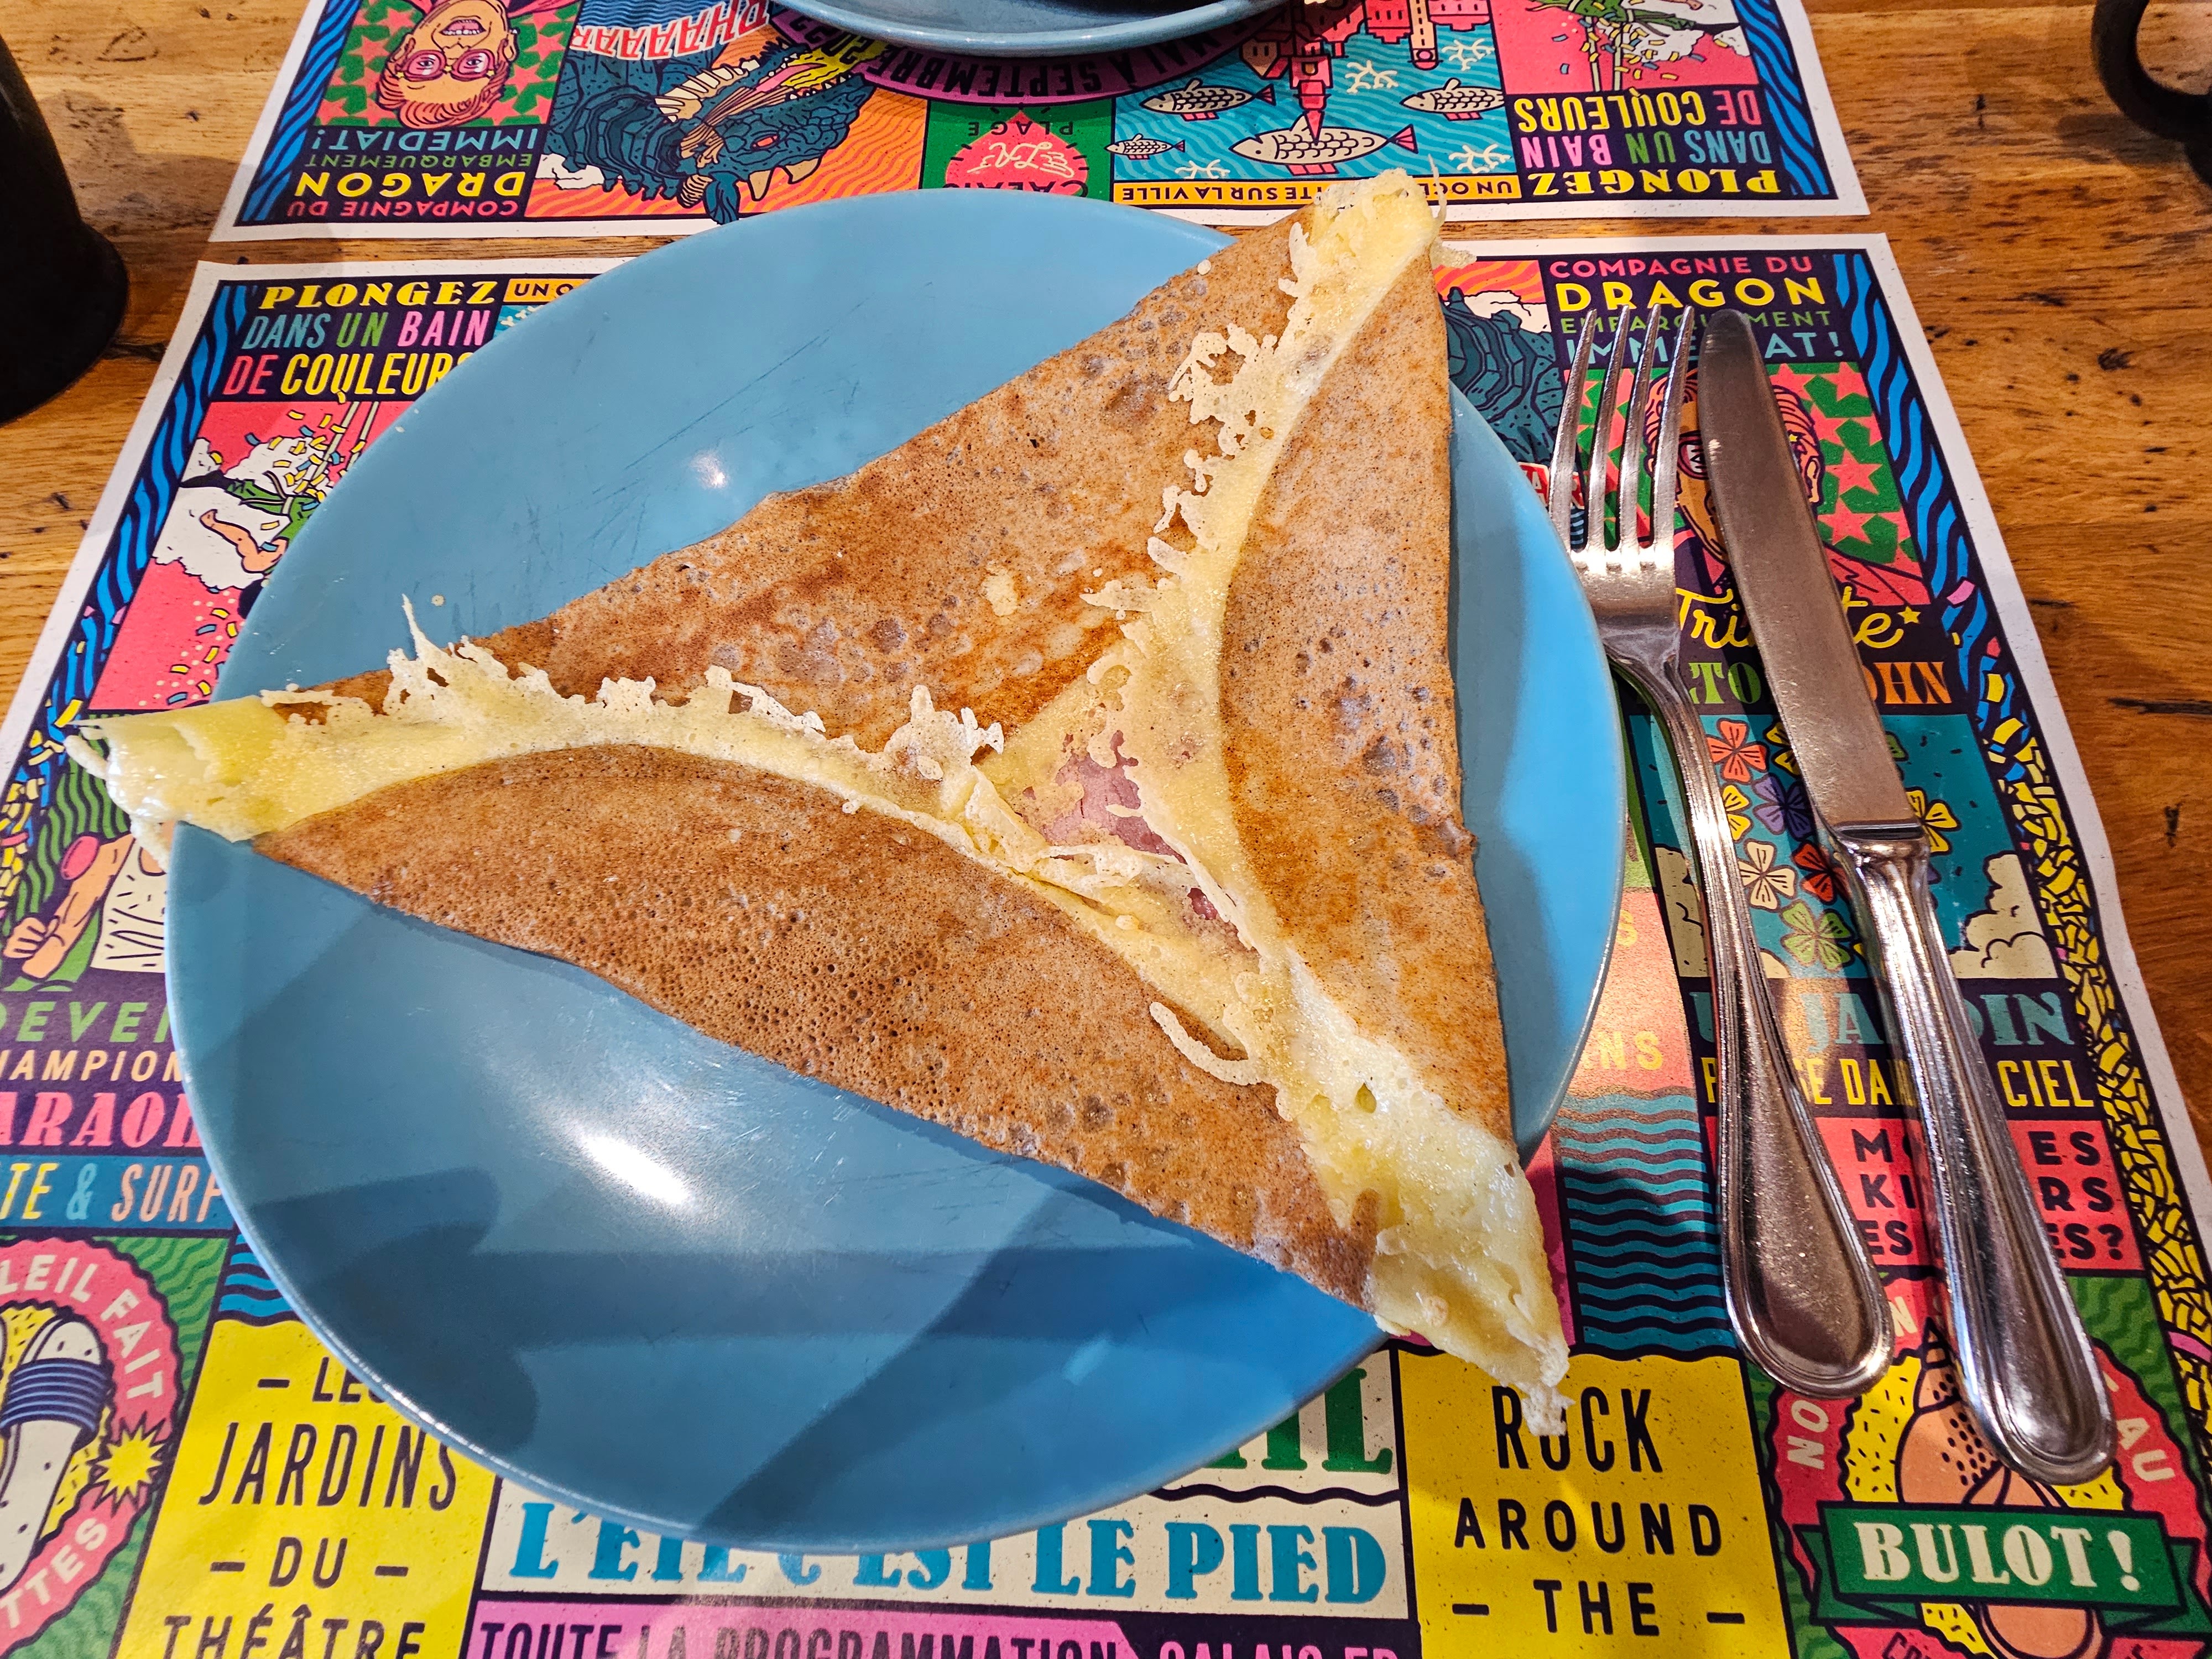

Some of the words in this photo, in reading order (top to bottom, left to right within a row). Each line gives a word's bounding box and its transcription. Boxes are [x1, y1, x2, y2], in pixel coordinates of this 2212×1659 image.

[866, 44, 1103, 98] SEPTEMBRE
[1514, 90, 1706, 133] COULEURS
[1713, 90, 1763, 126] DE
[968, 121, 1074, 137] PLAGE
[305, 154, 531, 168] EMBARQUEMENT
[1521, 134, 1612, 169] BAIN
[1626, 131, 1677, 164] UN
[1684, 129, 1773, 164] DANS
[295, 172, 525, 199] DRAGON
[1123, 187, 1188, 200] VILLE
[1188, 187, 1223, 201] LA
[1231, 186, 1279, 201] SUR
[1478, 181, 1512, 194] UN
[1528, 169, 1782, 196] PLONGEZ
[286, 201, 325, 218] DU
[341, 200, 518, 217] COMPAGNIE
[1550, 258, 1751, 278] COMPAGNIE
[1767, 256, 1812, 273] DU
[258, 280, 498, 309] PLONGEZ
[514, 283, 550, 296] UN
[1556, 278, 1825, 311] DRAGON
[242, 313, 331, 349] DANS
[336, 313, 389, 347] UN
[397, 310, 491, 347] BAIN
[223, 354, 279, 395] DE
[1999, 1060, 2095, 1107] CIEL
[66, 1163, 98, 1220] &
[101, 1289, 163, 1399] FAIT
[198, 1422, 457, 1512] JARDINS
[1454, 1498, 1721, 1557] AROUND
[269, 1537, 348, 1588] DU
[1031, 1519, 1136, 1599] LE
[1165, 1522, 1387, 1604] PIED
[1533, 1579, 1660, 1636] THE
